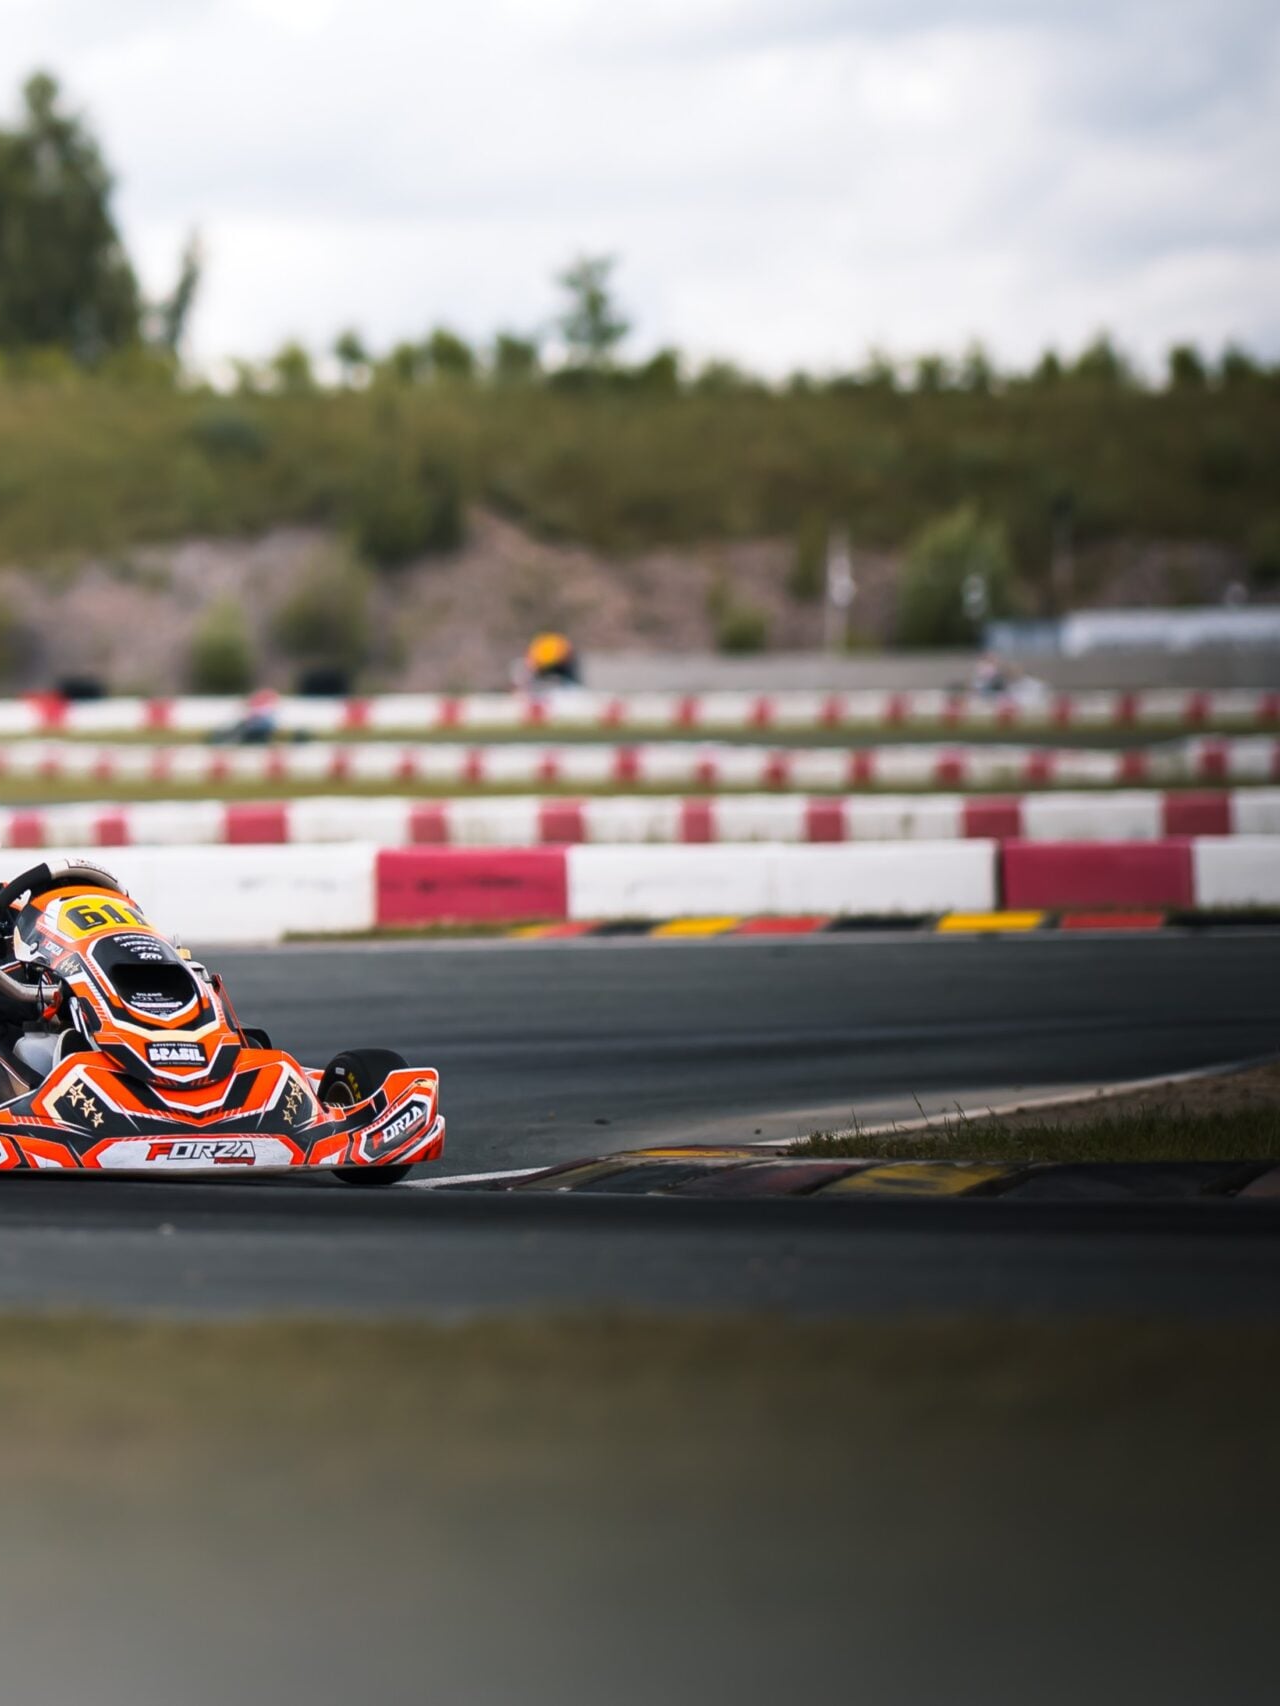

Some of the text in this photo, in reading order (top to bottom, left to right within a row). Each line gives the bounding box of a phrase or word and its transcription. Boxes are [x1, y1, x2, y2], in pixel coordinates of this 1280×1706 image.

[148, 1048, 205, 1061] BRASIL
[372, 1105, 424, 1149] FORZA
[146, 1141, 256, 1161] FORZA
